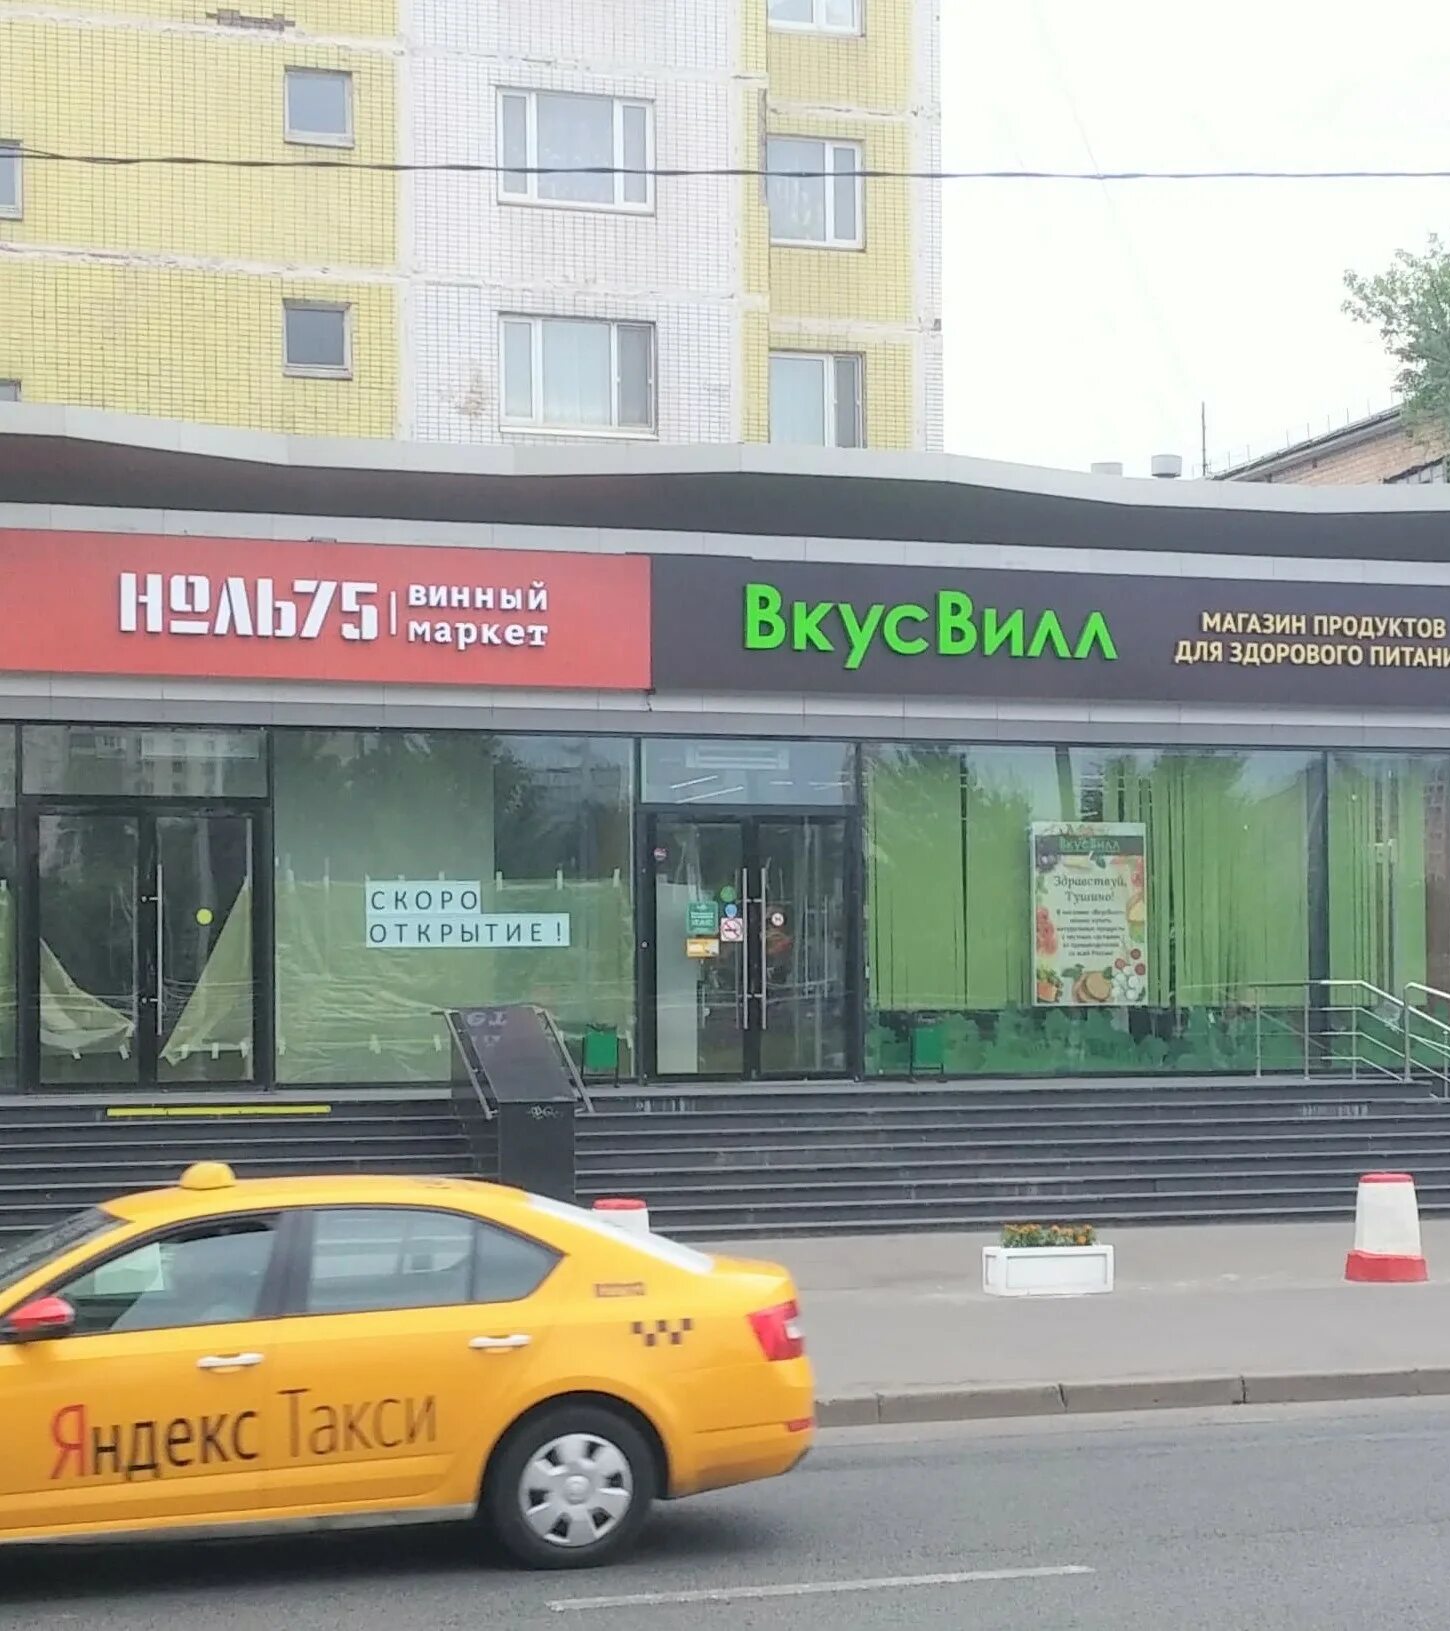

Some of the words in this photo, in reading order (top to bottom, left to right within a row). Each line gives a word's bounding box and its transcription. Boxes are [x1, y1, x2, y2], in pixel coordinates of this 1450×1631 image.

[408, 580, 549, 611] винный
[408, 619, 550, 651] маркет
[744, 583, 1118, 669] ВкусВилл
[1201, 611, 1306, 635] МАГАЗИН
[1313, 614, 1447, 640] ПРОДУКТОВ
[1174, 640, 1223, 664] ДЛЯ
[1229, 641, 1364, 667] ЗДОРОВОГО
[371, 890, 478, 911] СКОРО
[49, 1403, 261, 1480] Яндекс
[276, 1387, 438, 1458] Такси
